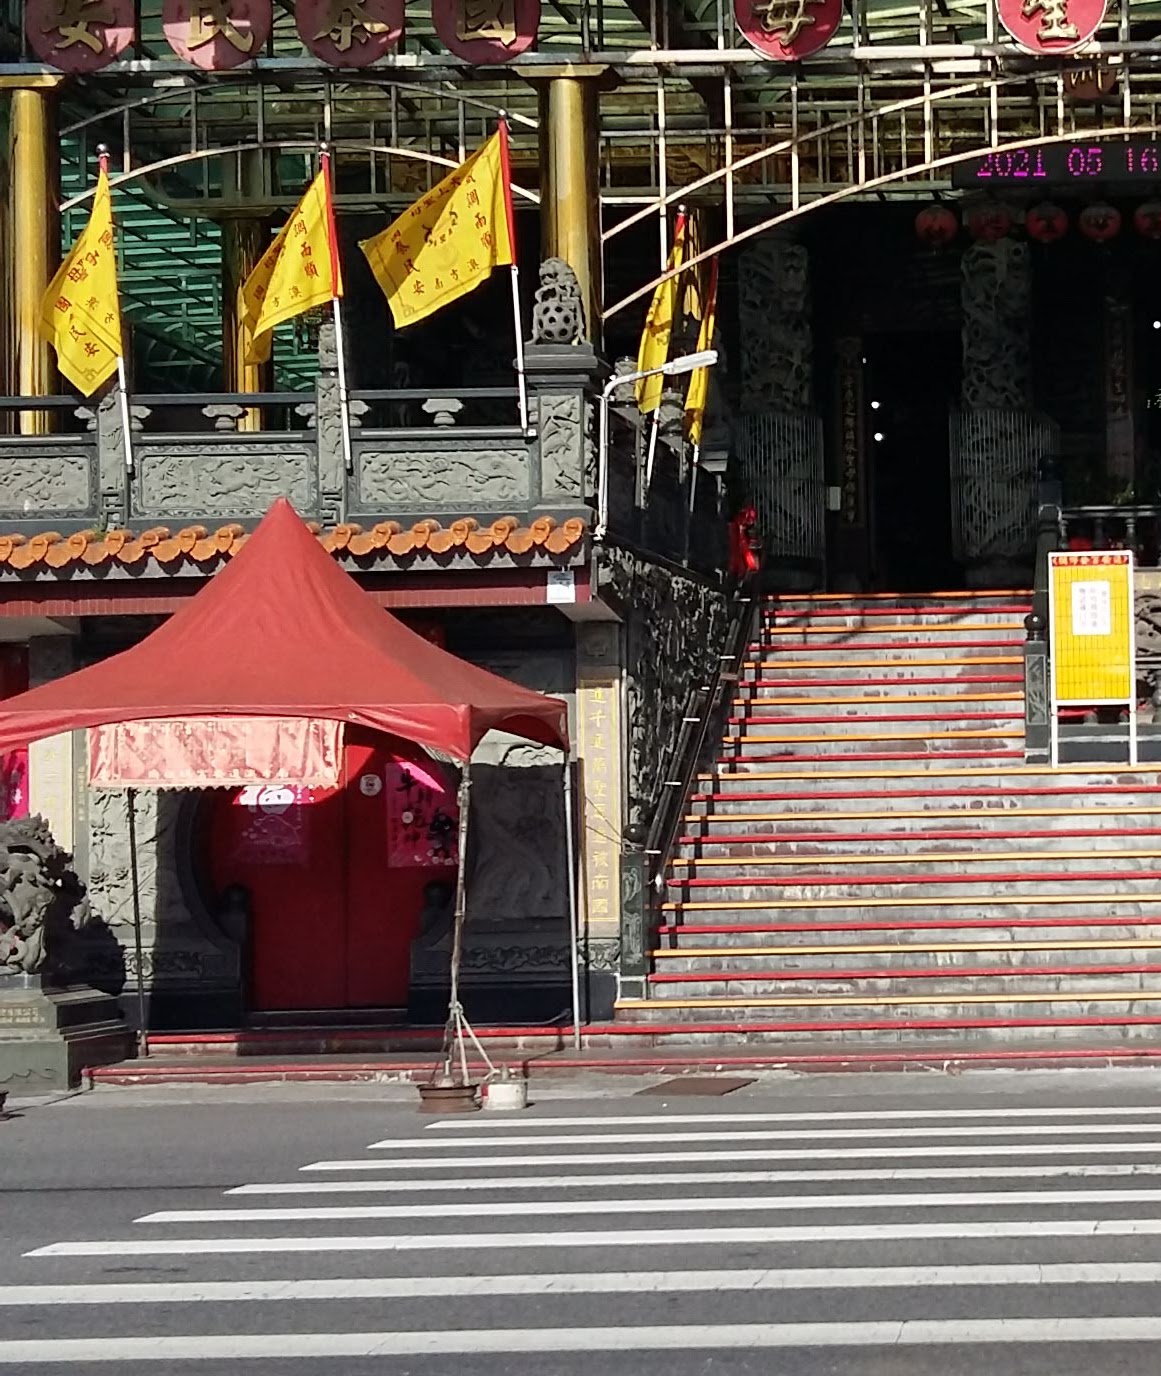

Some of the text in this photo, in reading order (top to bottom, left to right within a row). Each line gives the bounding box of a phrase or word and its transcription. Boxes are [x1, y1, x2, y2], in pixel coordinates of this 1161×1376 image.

[976, 147, 1159, 177] 2021 05 16
